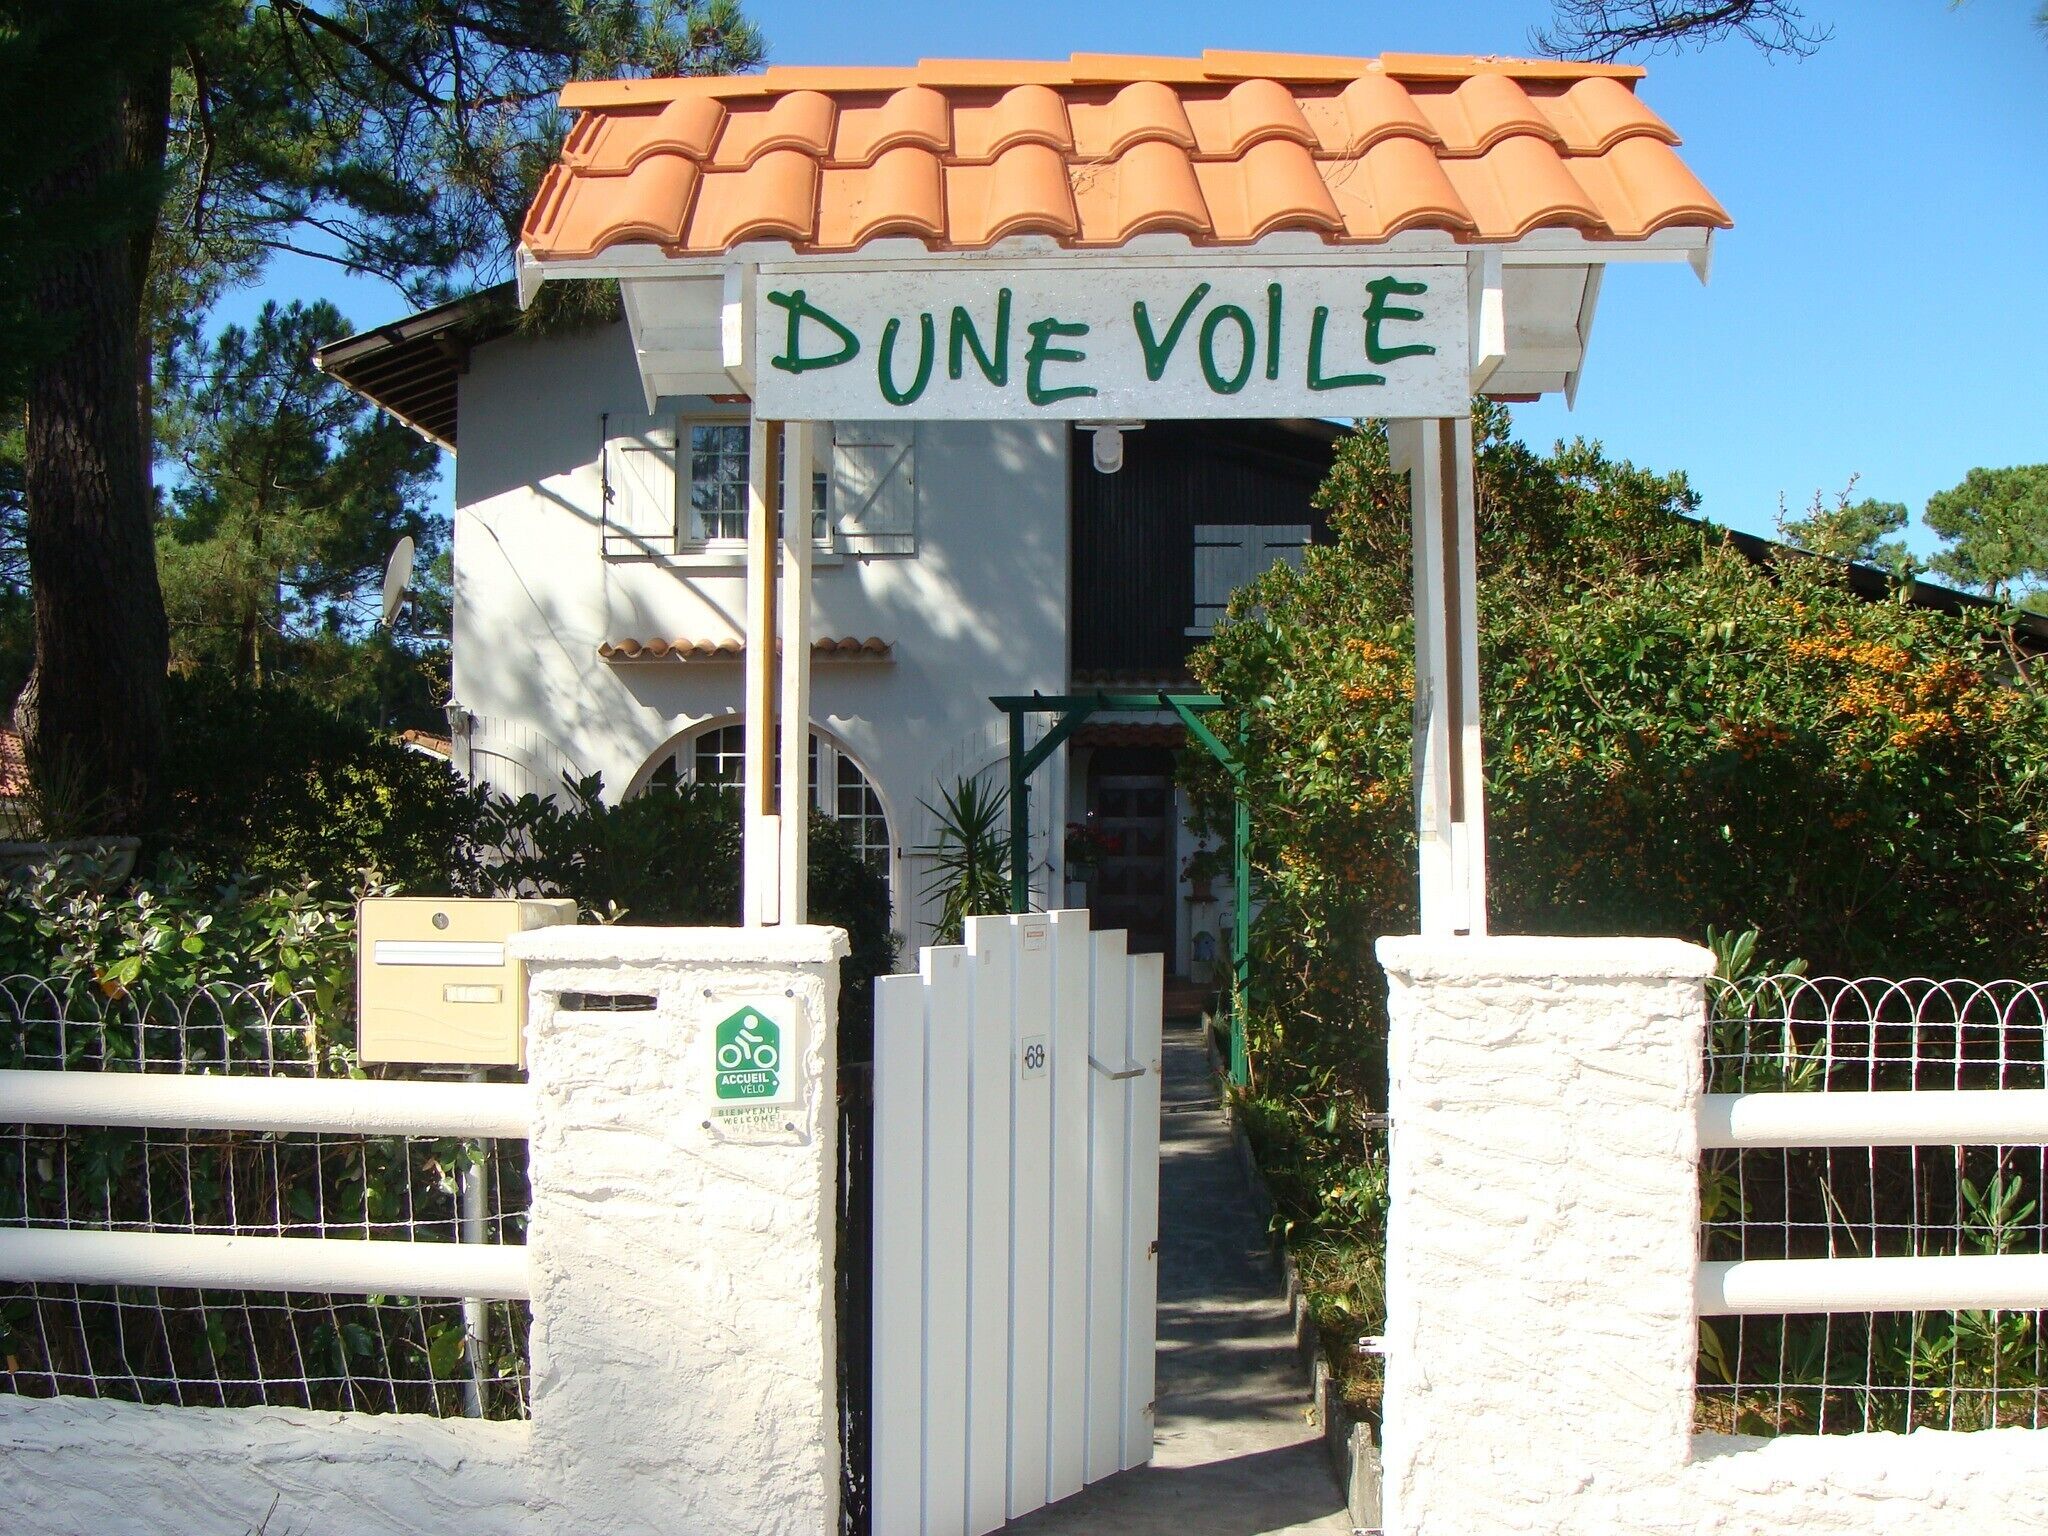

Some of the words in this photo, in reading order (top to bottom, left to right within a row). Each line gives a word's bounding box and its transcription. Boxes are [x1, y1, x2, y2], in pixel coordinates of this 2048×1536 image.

[767, 289, 1098, 406] DUNE
[1132, 276, 1437, 394] VOILE
[1026, 1044, 1044, 1070] 68
[721, 1073, 769, 1085] ACCUEIL
[740, 1082, 765, 1094] VÉLO
[718, 1107, 780, 1116] BIENVENUE
[723, 1115, 775, 1124] WELCOME
